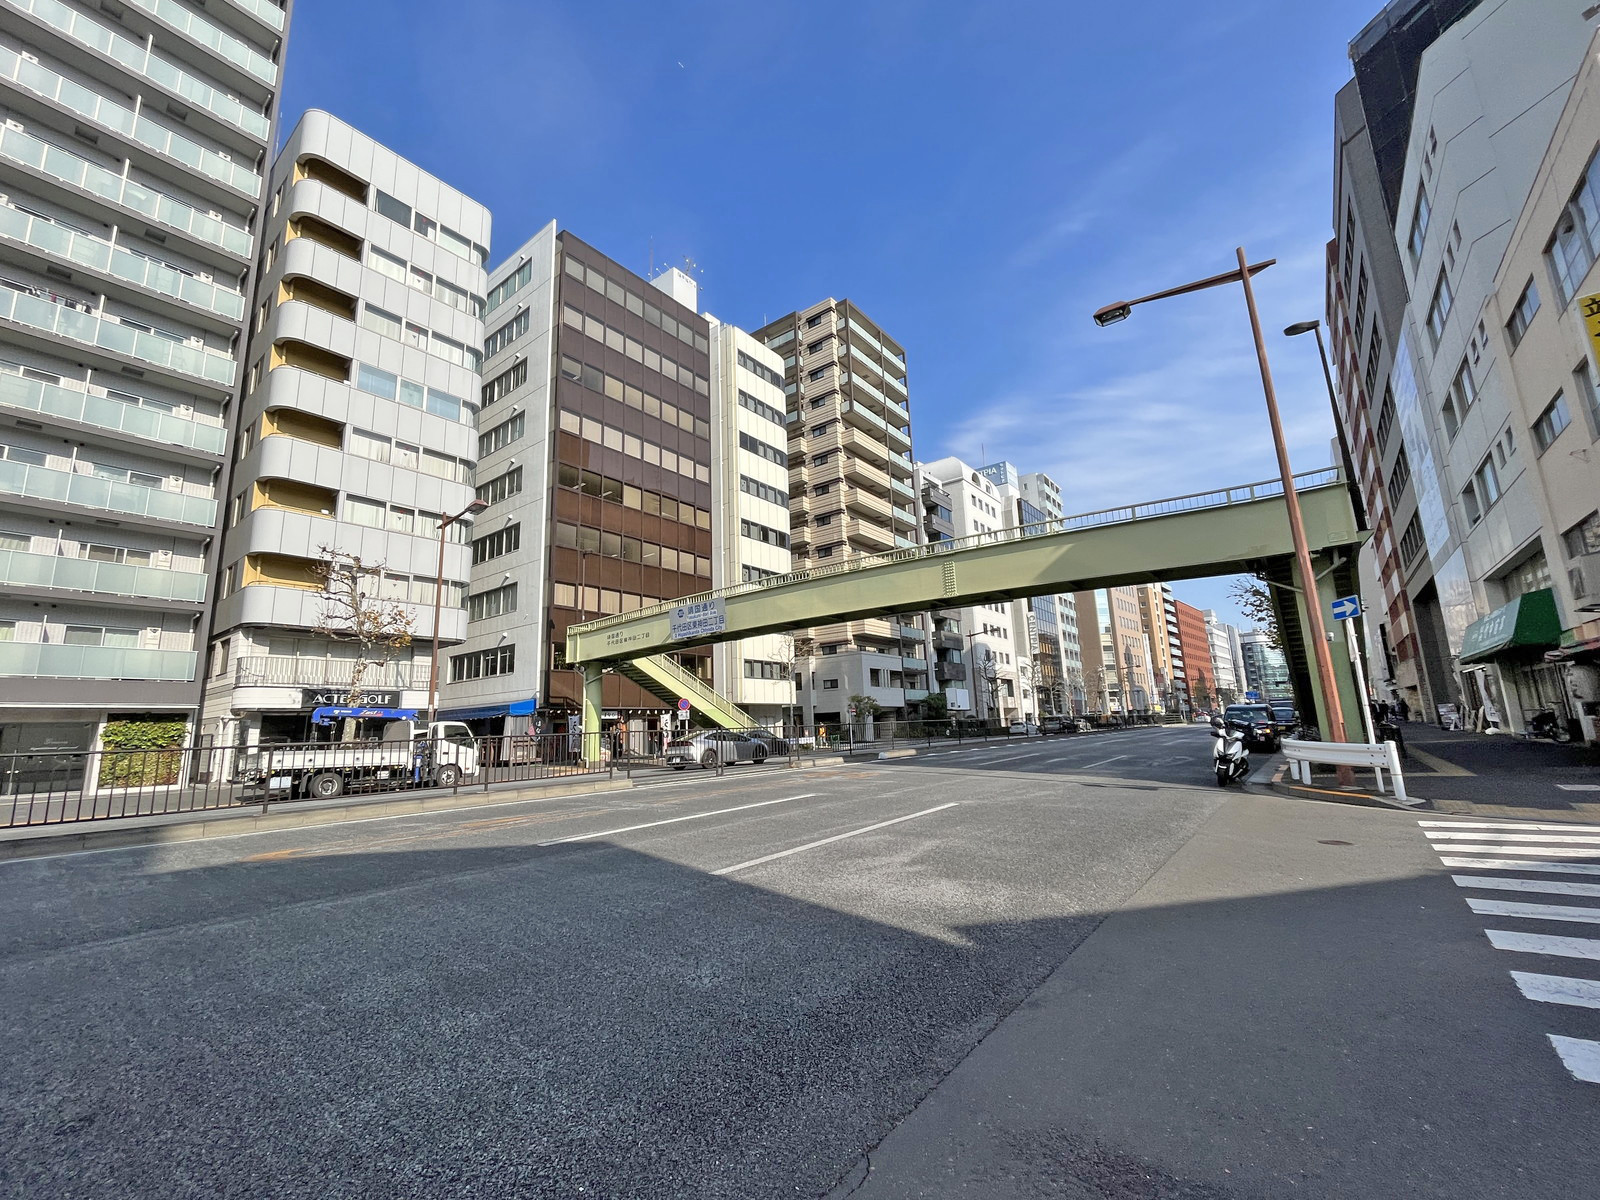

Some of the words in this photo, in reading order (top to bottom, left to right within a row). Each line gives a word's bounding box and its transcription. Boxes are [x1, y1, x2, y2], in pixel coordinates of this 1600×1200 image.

[672, 615, 725, 632] 千代田区東神田二丁目
[360, 694, 392, 704] GOLF
